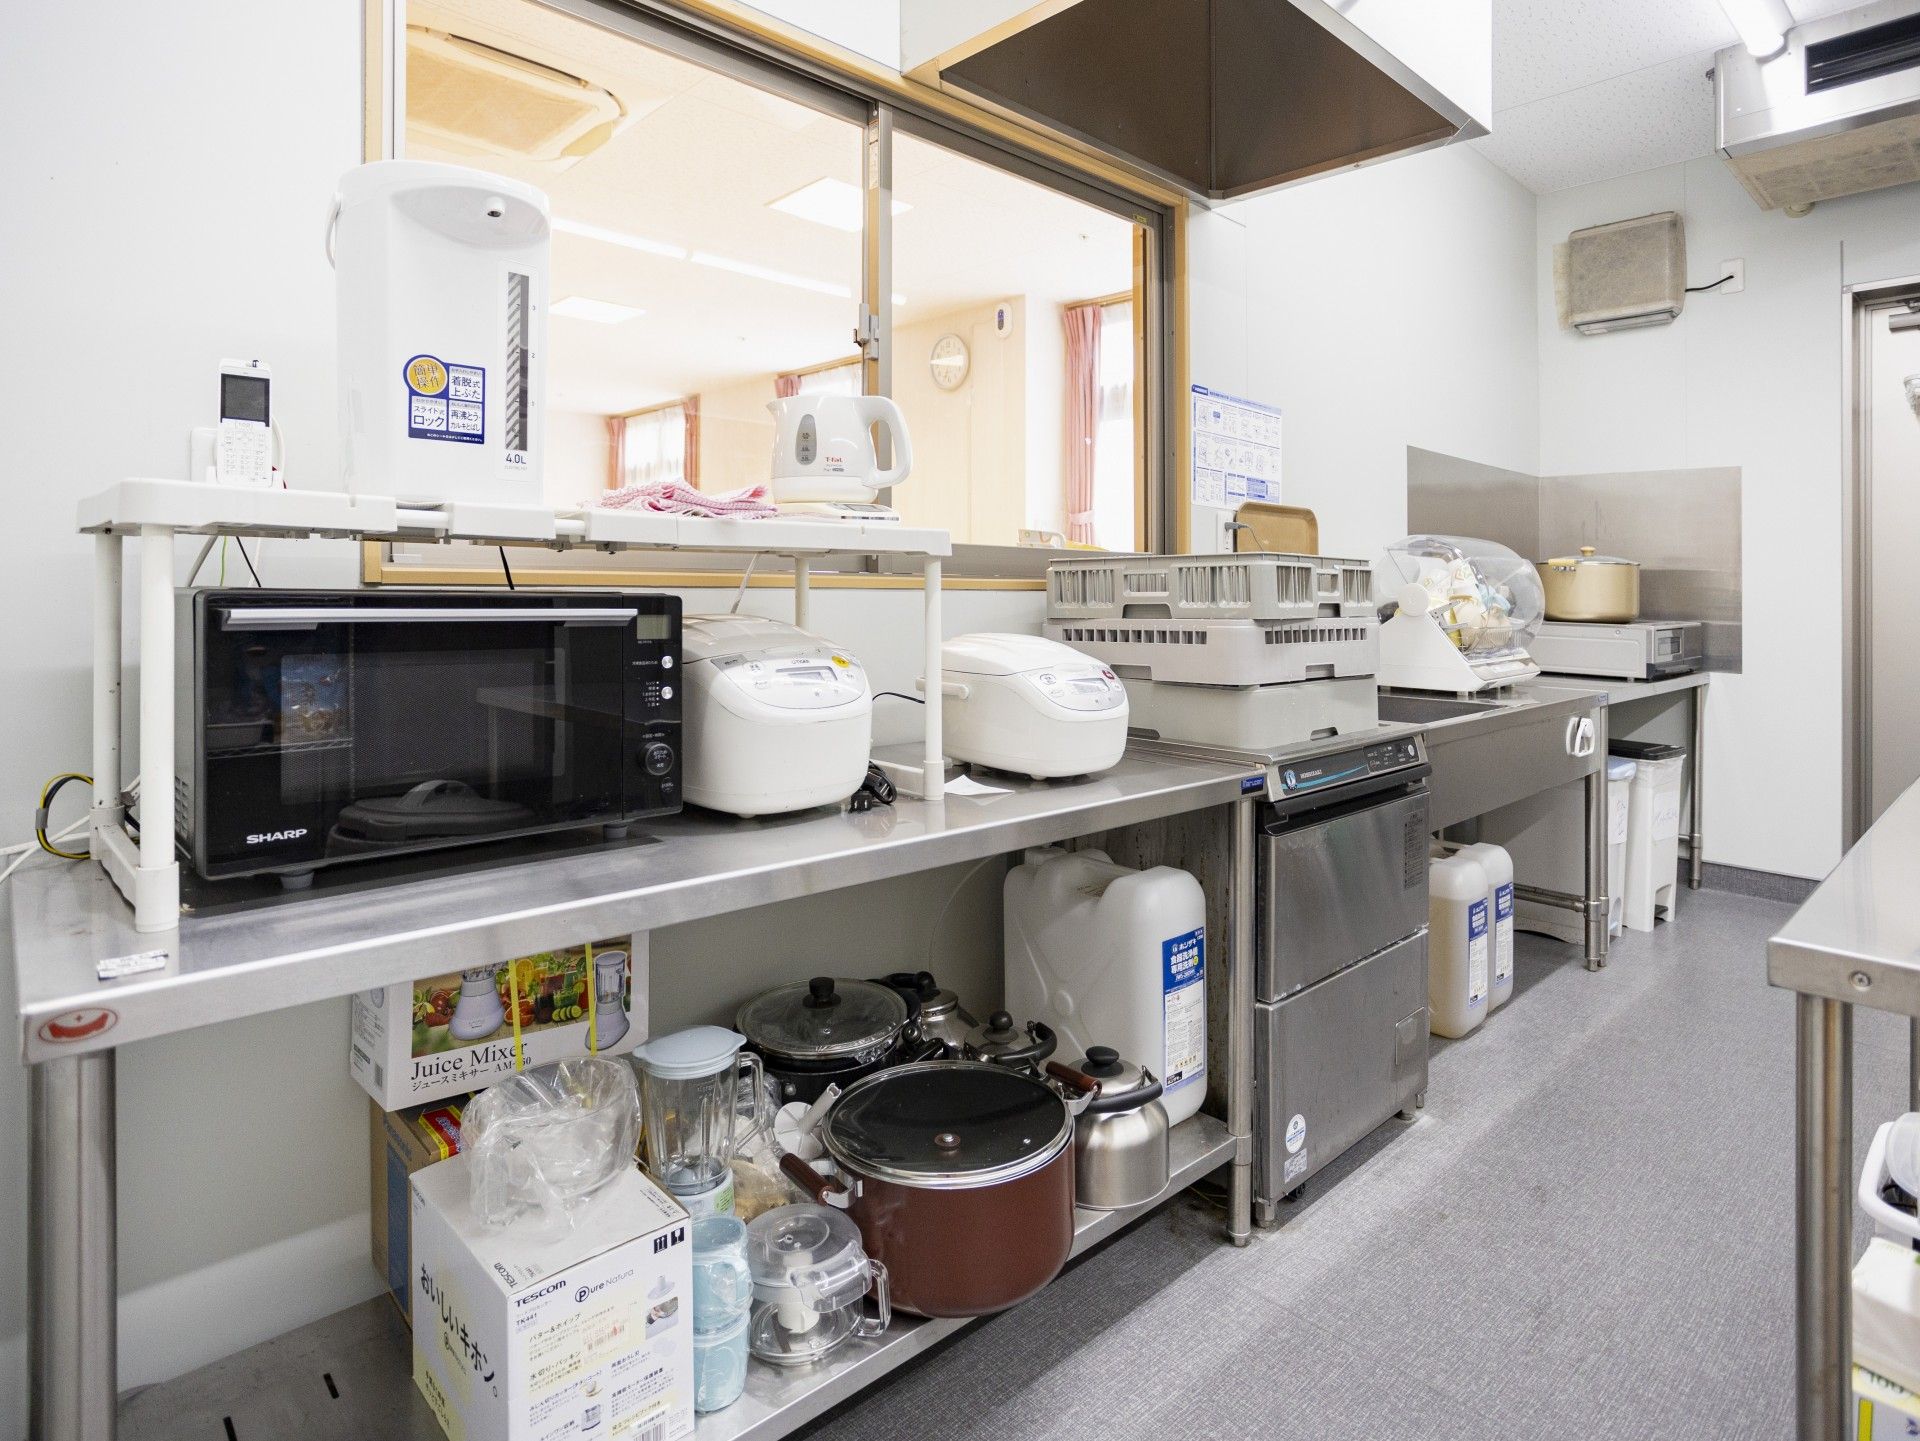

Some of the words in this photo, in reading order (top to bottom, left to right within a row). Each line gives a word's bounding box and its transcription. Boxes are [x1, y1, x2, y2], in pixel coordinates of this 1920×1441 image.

[413, 364, 438, 376] 簡単
[417, 376, 439, 389] 操作
[451, 376, 481, 389] 着脱式
[451, 387, 481, 400] 上ぶた
[414, 415, 445, 428] ロック
[506, 453, 527, 464] 4.0L
[246, 828, 308, 844] SHARP
[411, 1056, 463, 1080] Juice
[471, 1043, 528, 1067] Mixer
[412, 1069, 489, 1092] ジュースミキサー
[606, 1268, 634, 1290] Natura
